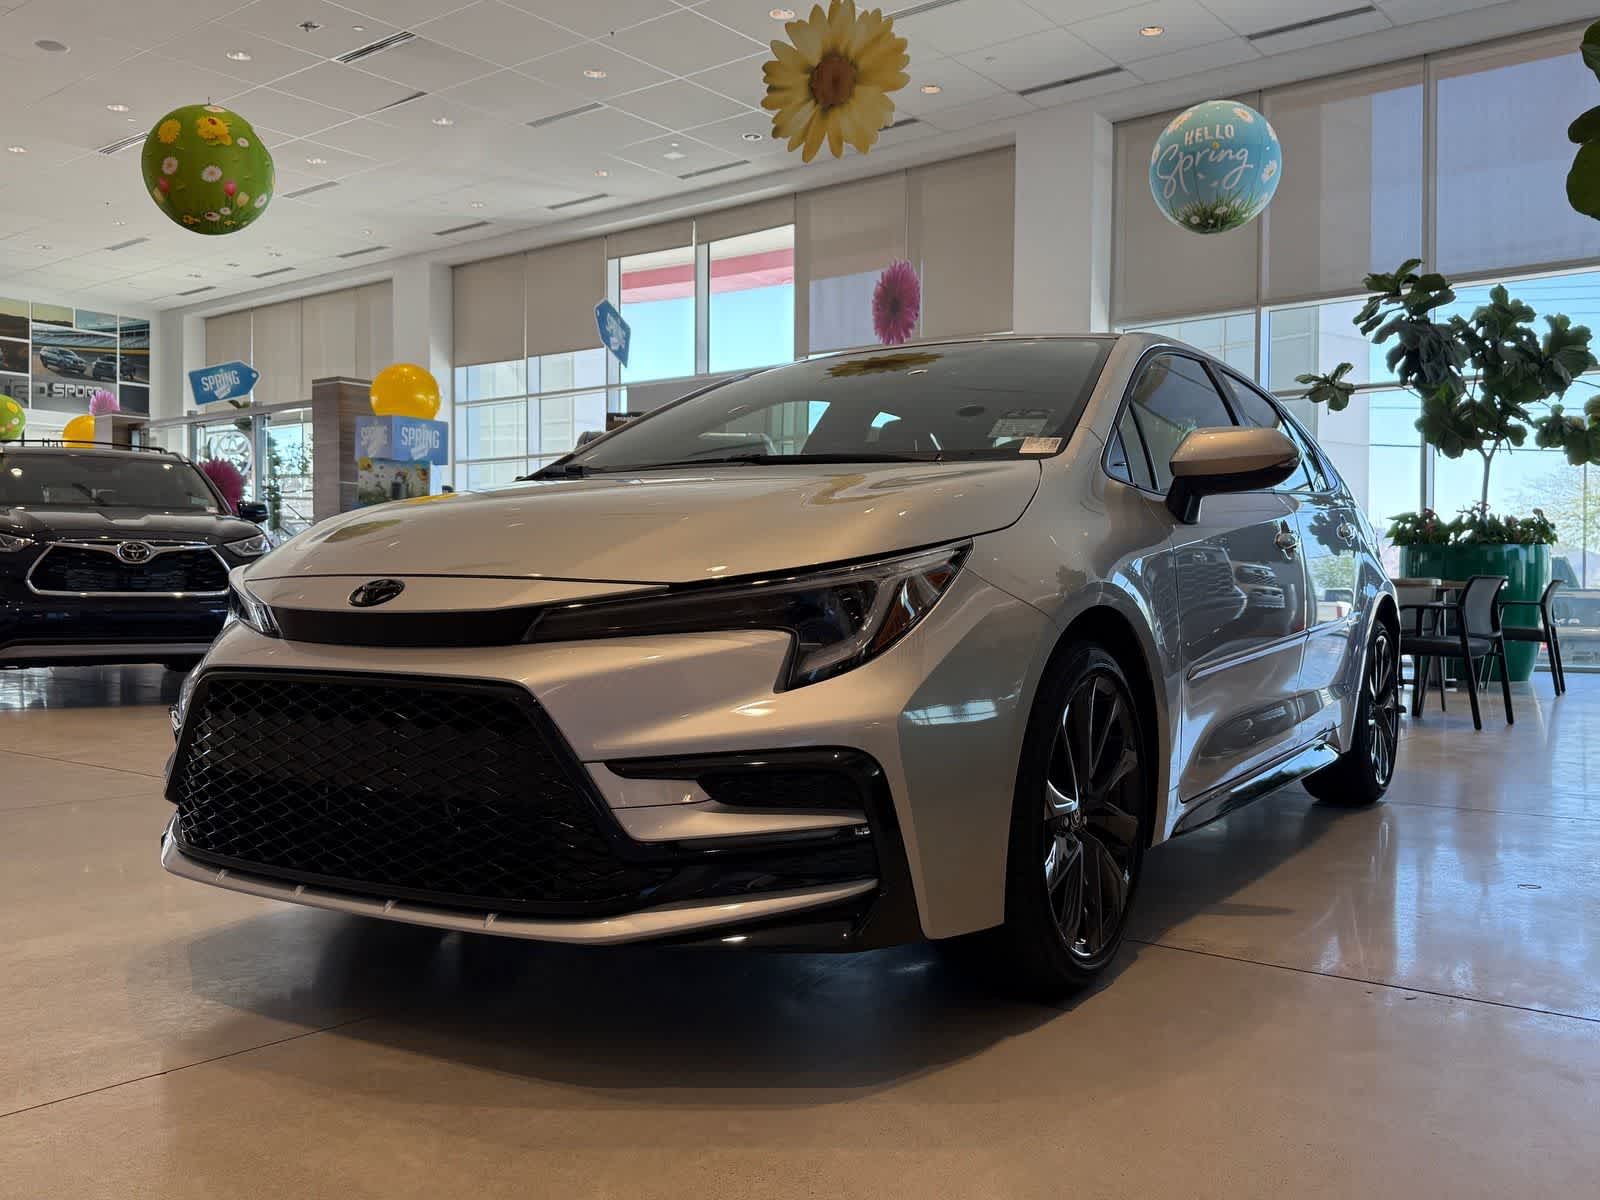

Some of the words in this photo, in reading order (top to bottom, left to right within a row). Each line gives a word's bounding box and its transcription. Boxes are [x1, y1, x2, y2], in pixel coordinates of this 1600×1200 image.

[1184, 124, 1235, 145] HELLO
[1156, 143, 1254, 199] Spring
[200, 369, 241, 392] SPRING
[400, 425, 440, 449] SPRING
